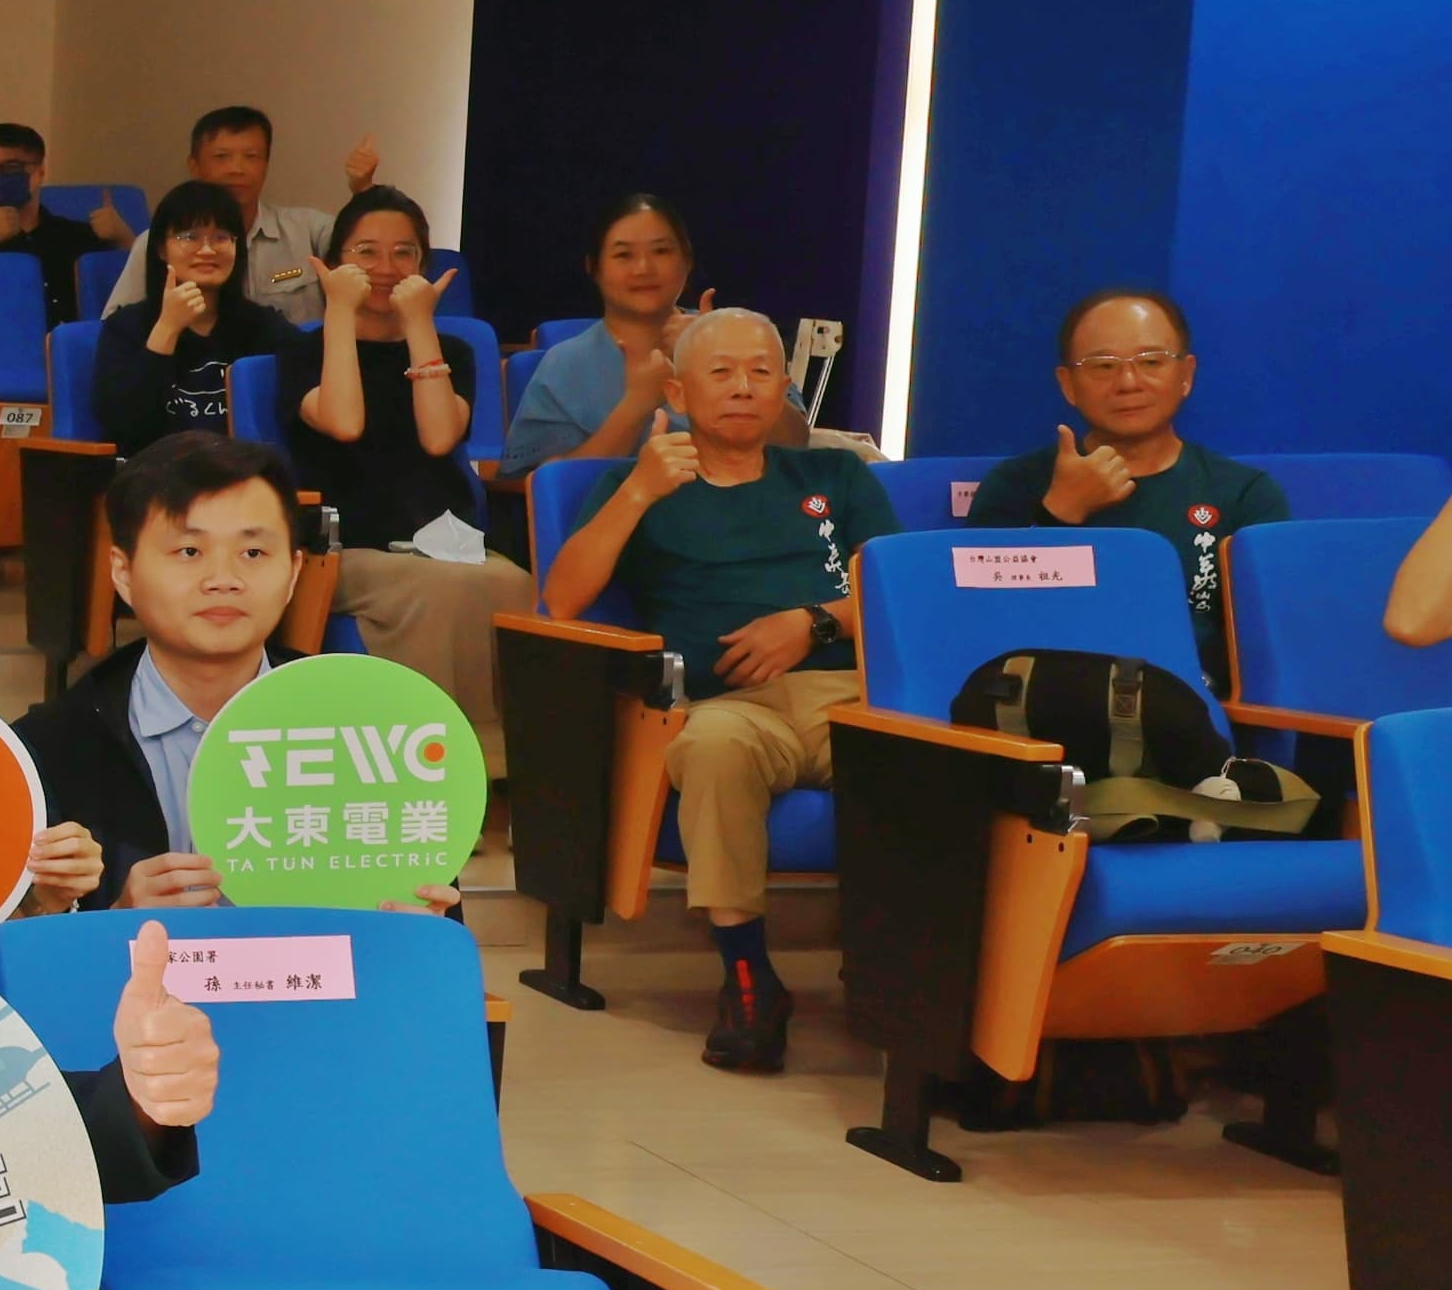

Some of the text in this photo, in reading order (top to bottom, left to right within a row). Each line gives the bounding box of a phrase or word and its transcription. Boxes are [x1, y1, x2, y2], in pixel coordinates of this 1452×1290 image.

[7, 412, 33, 423] 087
[227, 801, 448, 848] 大東電業
[228, 857, 255, 872] TA
[166, 949, 219, 964] 家公園署
[204, 975, 222, 992] 孫
[285, 973, 323, 992] 維潔
